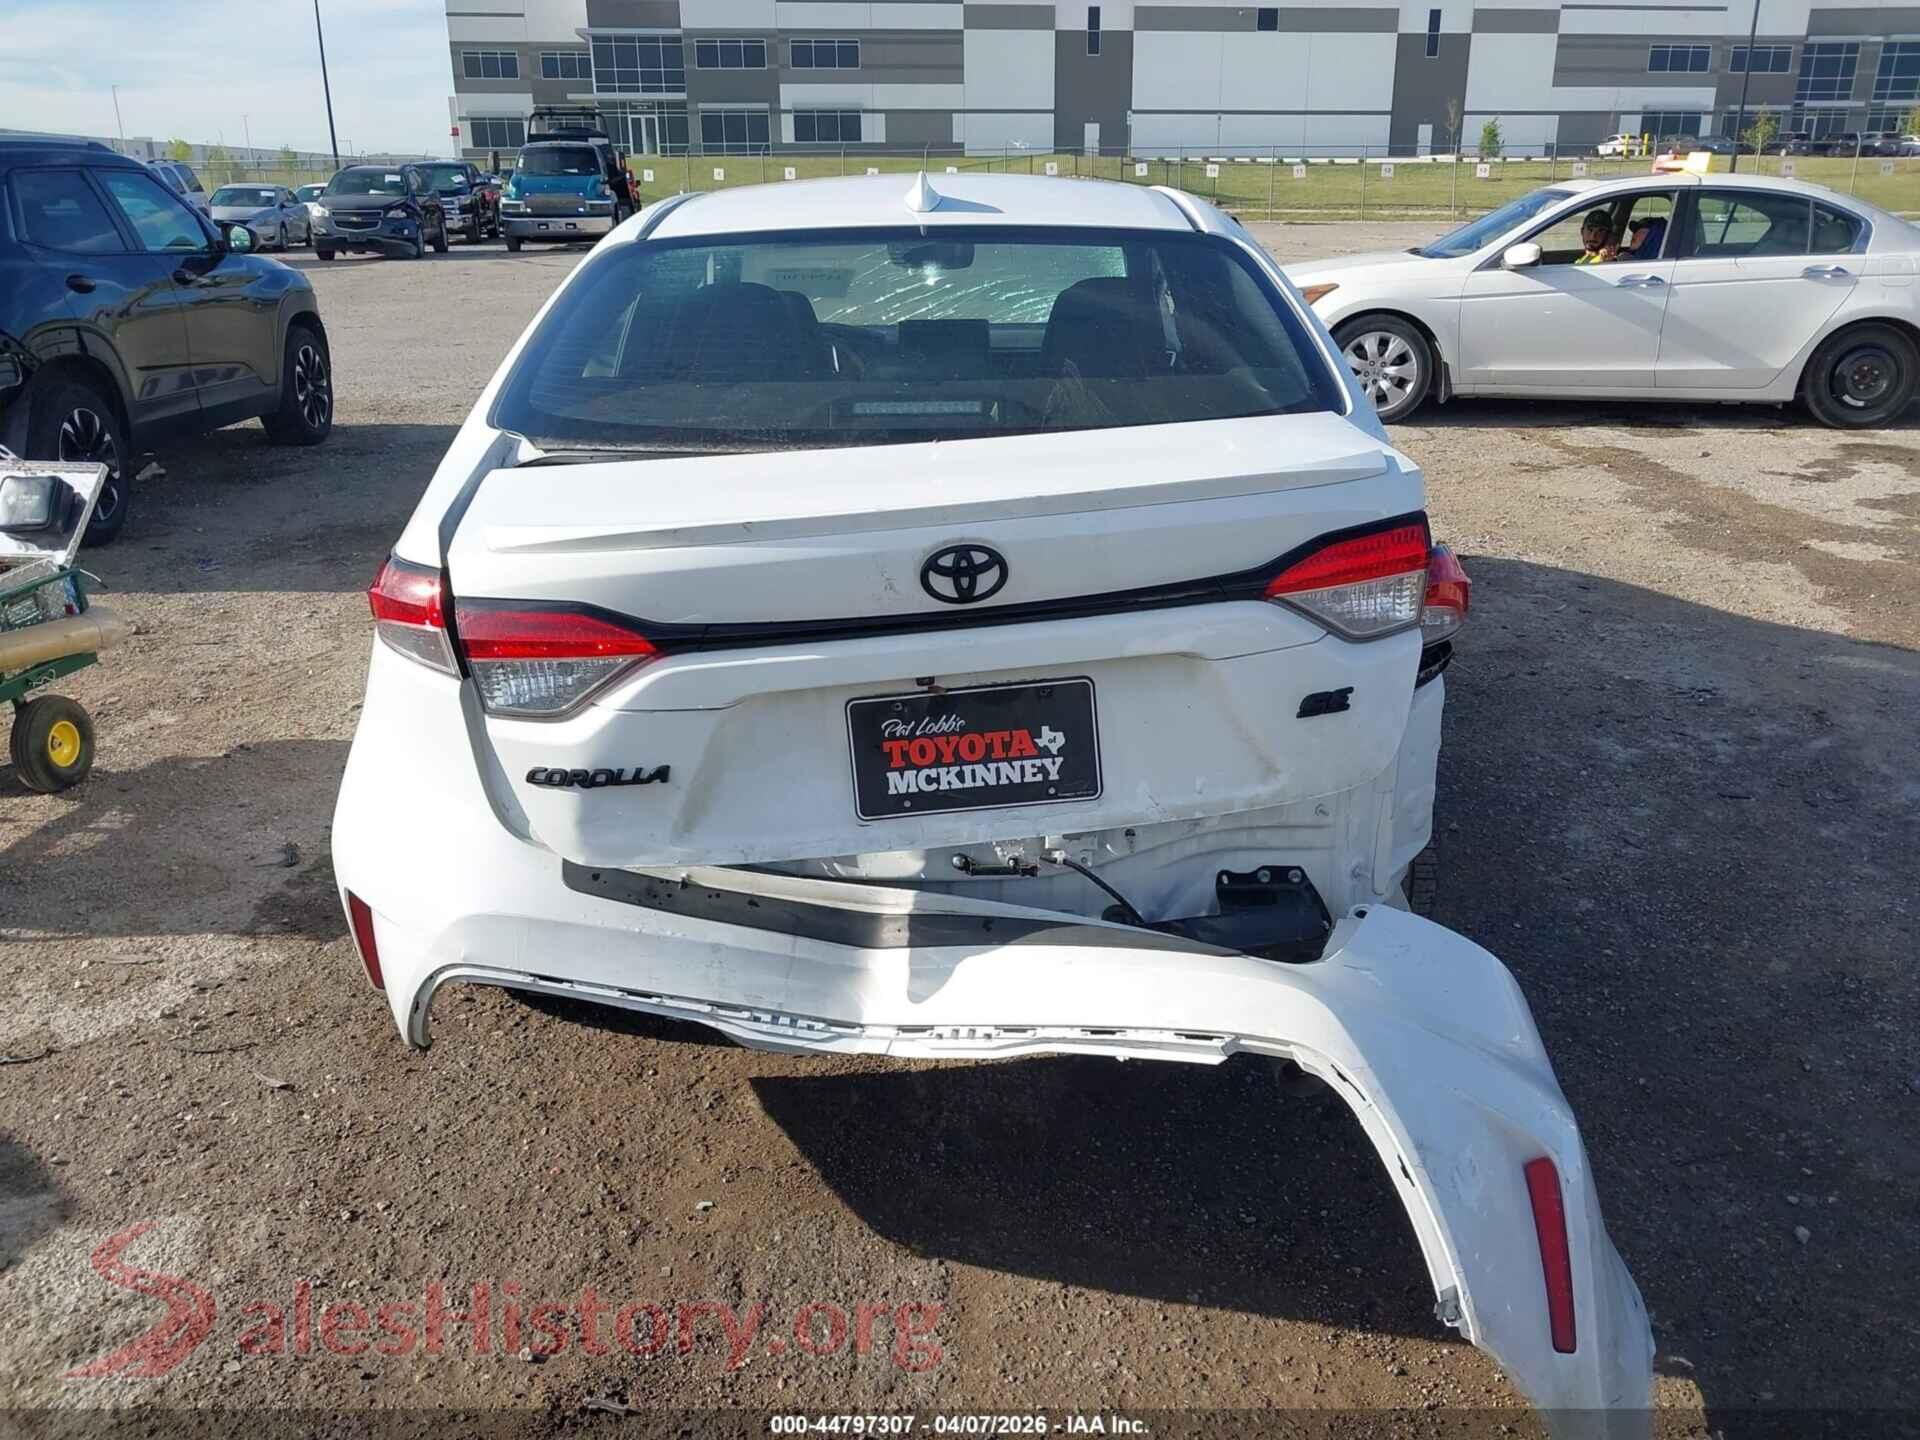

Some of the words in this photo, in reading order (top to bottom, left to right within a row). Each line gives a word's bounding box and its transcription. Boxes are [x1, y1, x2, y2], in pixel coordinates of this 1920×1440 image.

[881, 718, 914, 738] Pat
[915, 714, 967, 736] Lobb's
[883, 729, 1040, 768] TOYOTA
[526, 765, 671, 789] COROLLA
[886, 757, 1064, 795] MCKINNEY
